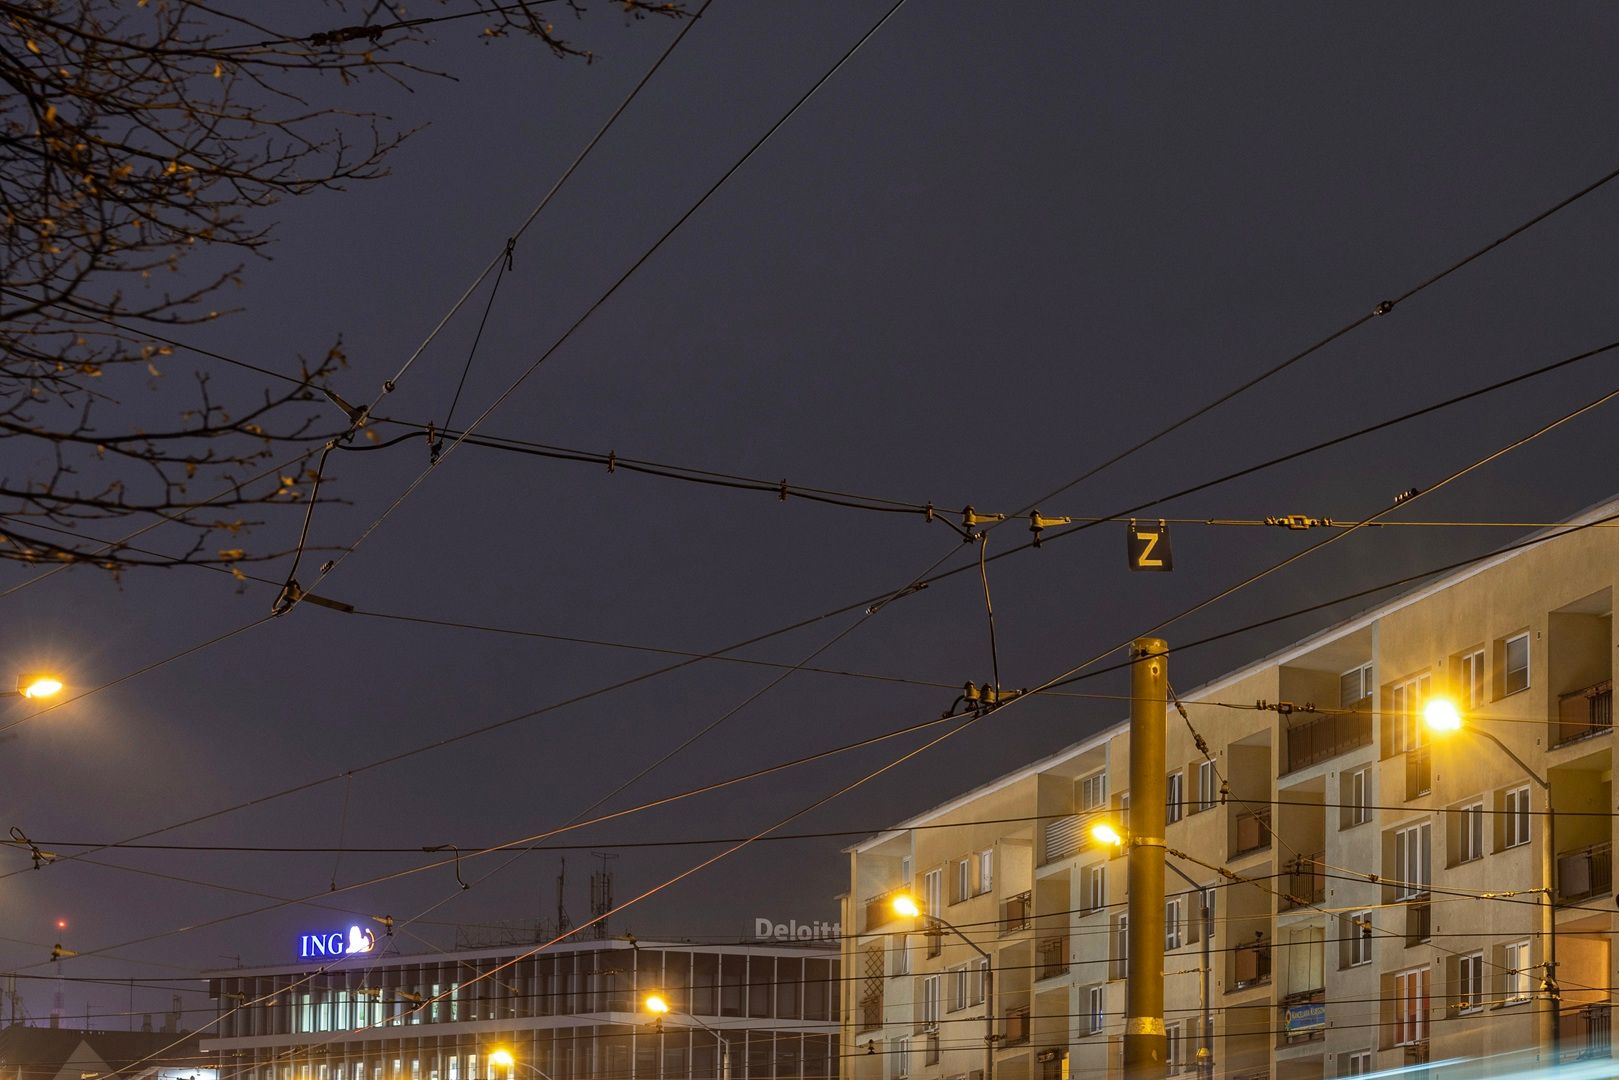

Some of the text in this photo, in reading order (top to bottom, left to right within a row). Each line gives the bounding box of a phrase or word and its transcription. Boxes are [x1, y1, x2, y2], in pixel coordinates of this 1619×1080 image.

[1136, 532, 1163, 567] Z
[755, 917, 841, 943] Deloitt
[301, 932, 344, 957] ING
